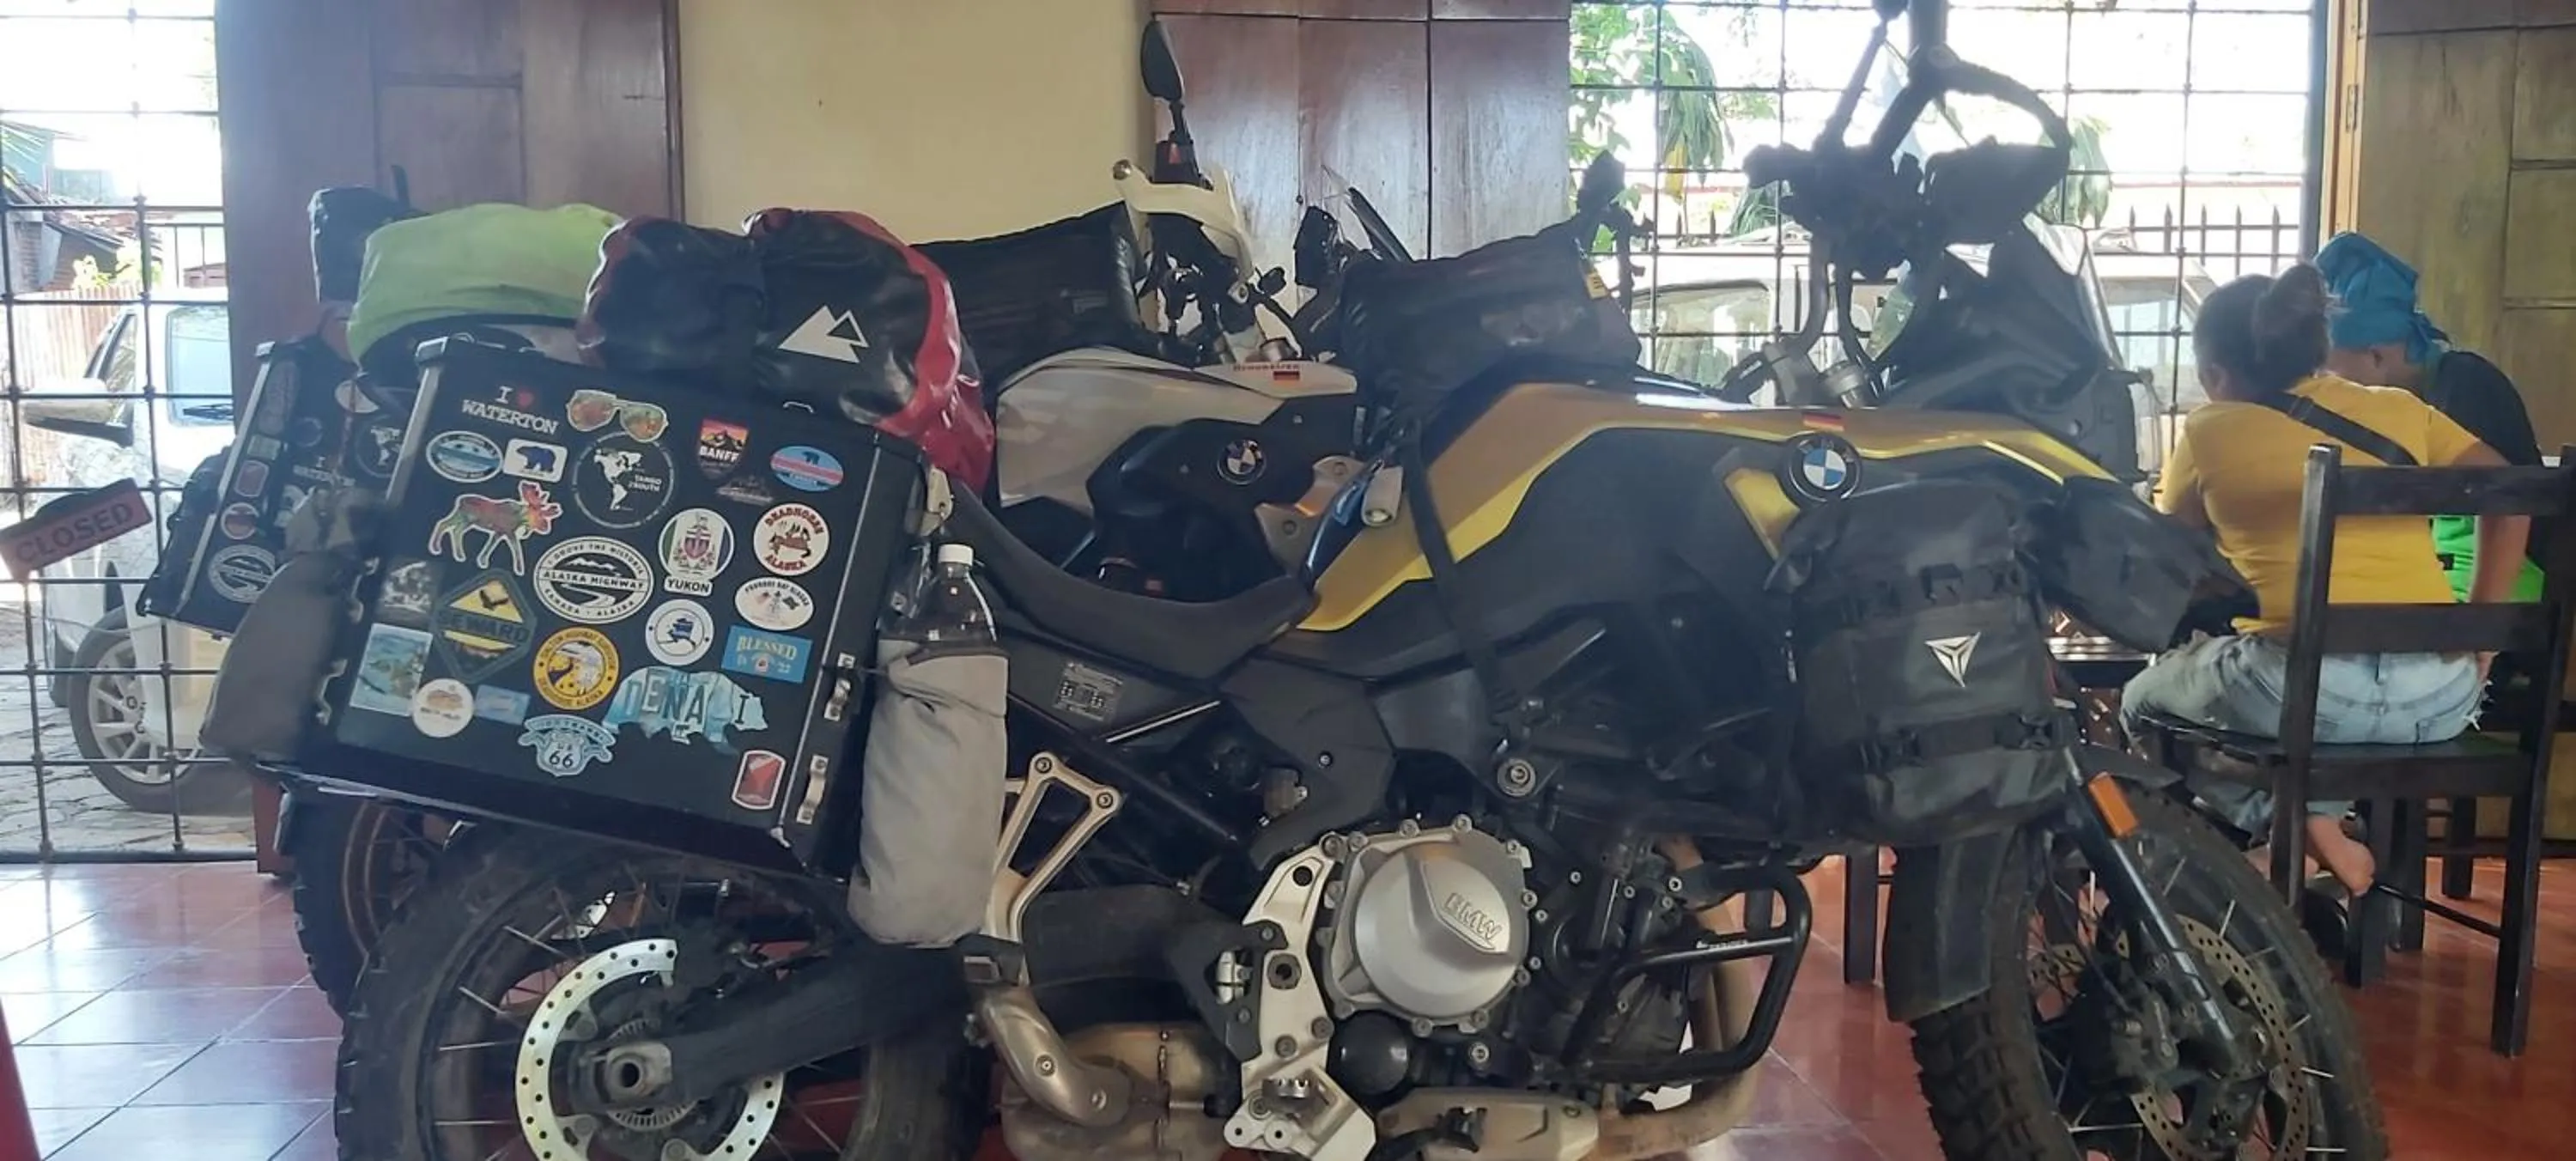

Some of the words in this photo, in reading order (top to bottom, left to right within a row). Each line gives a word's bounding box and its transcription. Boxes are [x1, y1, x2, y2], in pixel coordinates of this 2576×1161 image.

[495, 386, 513, 404] I
[461, 399, 559, 435] WATERTON
[698, 445, 740, 464] BANFF
[15, 502, 133, 562] CLOSED
[544, 570, 587, 583] ALASKA
[590, 576, 645, 590] HIGHWAY
[668, 578, 710, 593] YUKON
[596, 599, 635, 617] ALASKA
[436, 611, 532, 644] SEWARD
[737, 635, 798, 660] BLESSED
[550, 750, 574, 769] 66
[1444, 892, 1503, 940] BMW
